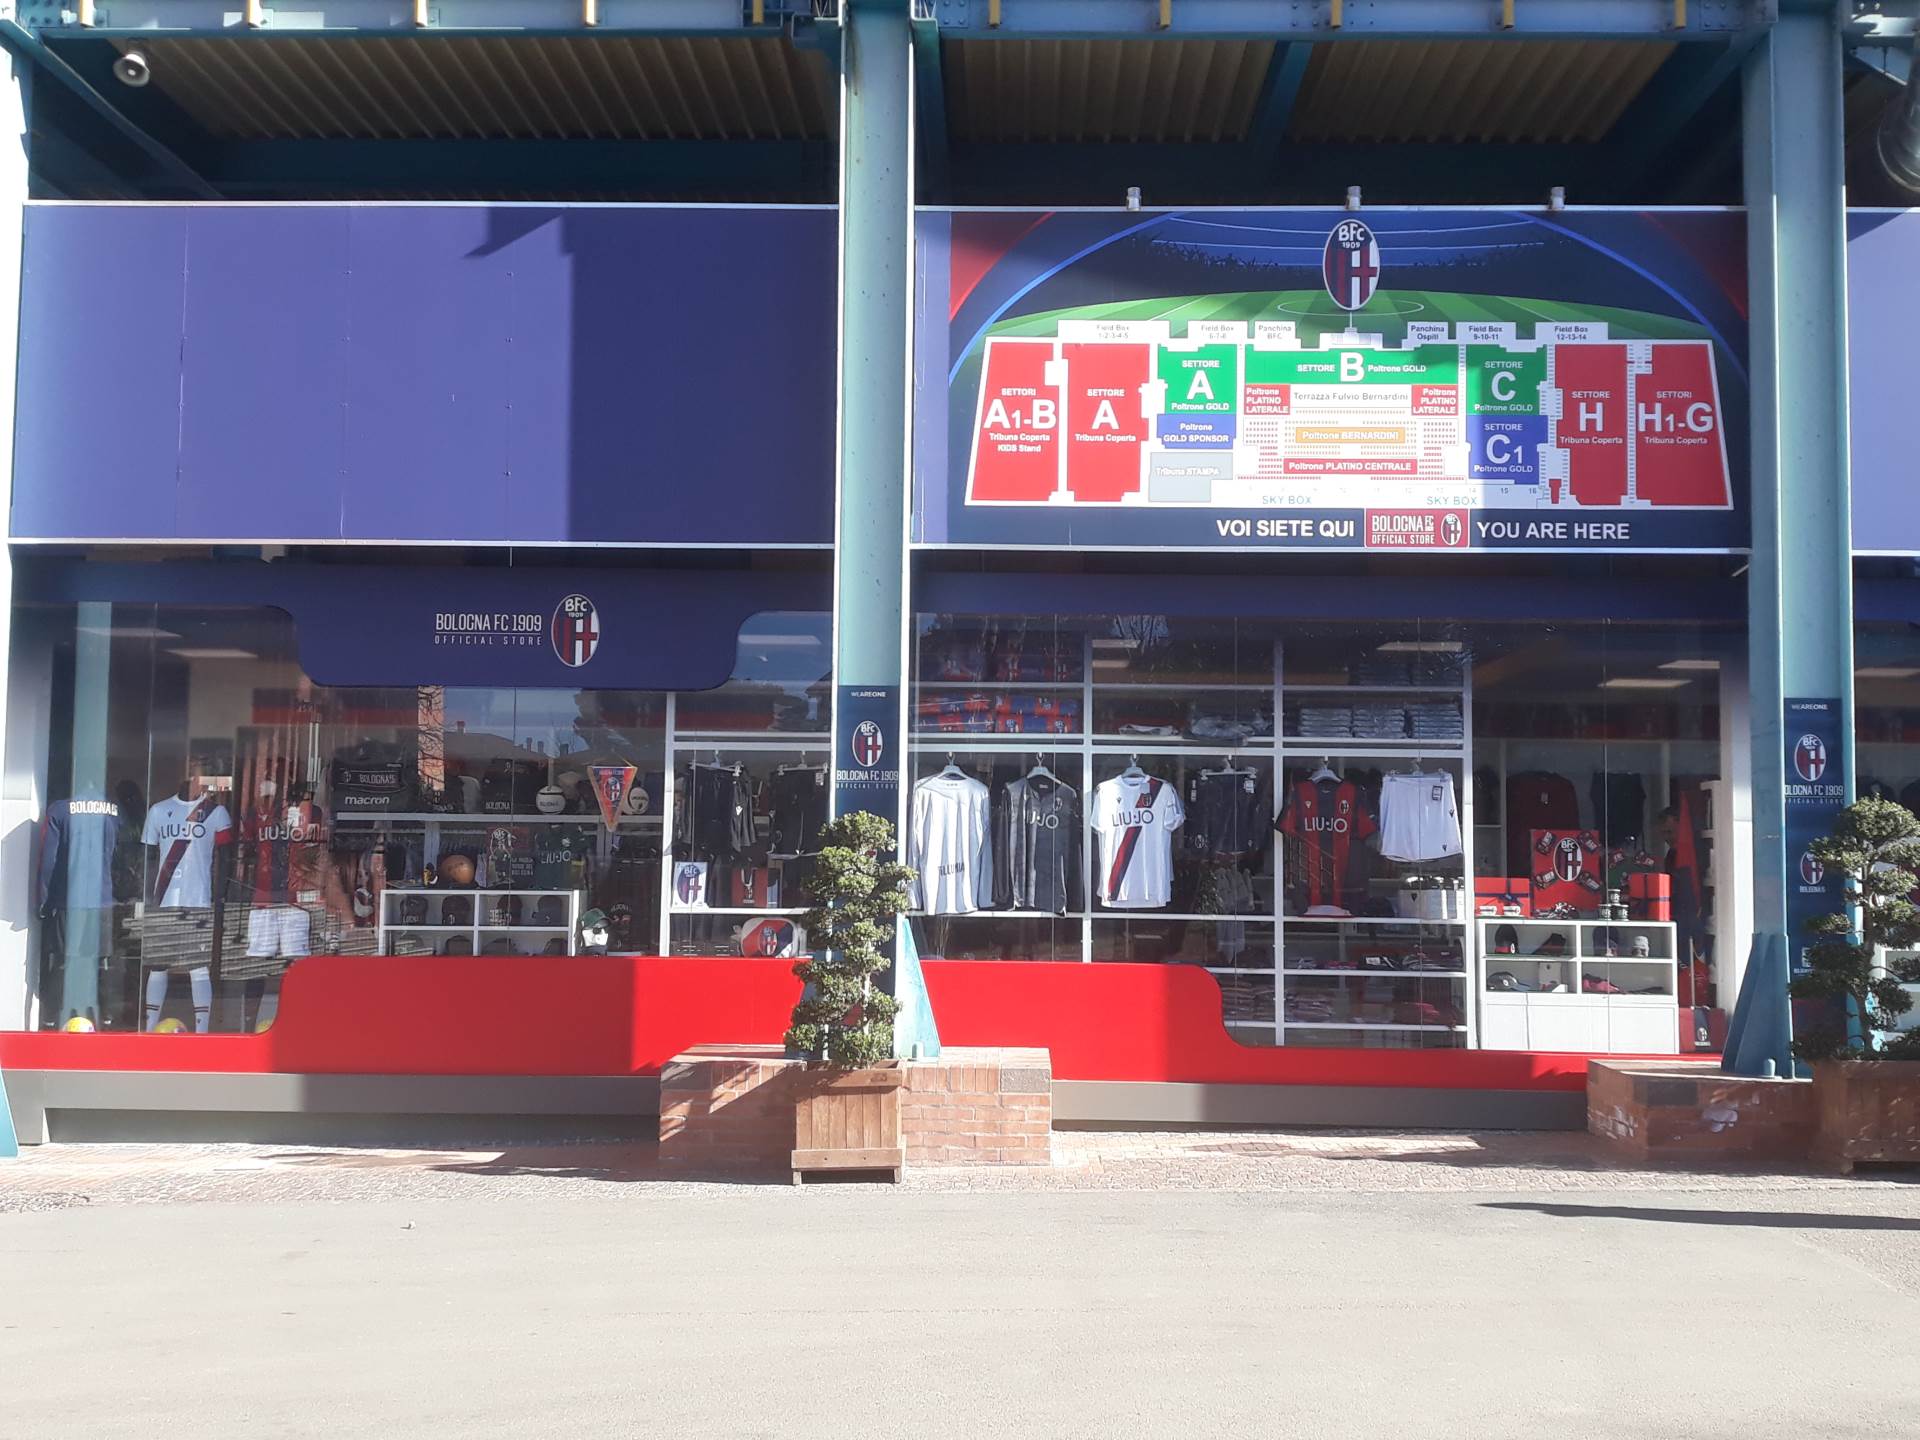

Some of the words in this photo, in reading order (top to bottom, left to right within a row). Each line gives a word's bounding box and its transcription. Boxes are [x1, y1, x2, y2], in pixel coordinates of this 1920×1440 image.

[1338, 223, 1365, 241] BFC
[1342, 241, 1360, 249] 1909
[1182, 360, 1220, 368] SETTORE
[1296, 364, 1335, 372] SETTORE
[1340, 352, 1365, 382] B
[1367, 364, 1400, 373] Poltrone
[1402, 364, 1426, 373] GOLD
[1484, 361, 1523, 369] SETTORE
[1186, 369, 1214, 400] A
[1491, 371, 1516, 401] C
[1001, 388, 1036, 396] SETTORI
[1087, 389, 1125, 397] SETTORE
[1246, 387, 1279, 395] Poltrone
[1423, 388, 1456, 396] Poltrone
[1572, 391, 1611, 399] SETTORE
[1656, 391, 1692, 399] SETTORI
[1294, 392, 1329, 400] Terrazza
[1332, 392, 1359, 400] Fulvio
[1362, 392, 1408, 400] Bernardini
[1246, 397, 1282, 405] PLATINO
[1420, 397, 1457, 405] PLATINO
[1171, 402, 1204, 411] Poltrone
[1205, 402, 1229, 411] GOLD
[1246, 406, 1289, 414] LATERALE
[1413, 406, 1456, 414] LATERALE
[983, 399, 1057, 429] A1-B
[1091, 400, 1120, 429] A
[1579, 402, 1603, 432] H
[1638, 402, 1714, 433] H1-G
[1180, 423, 1212, 431] Poltrone
[1485, 423, 1523, 431] SETTORE
[989, 433, 1018, 441] Tribuna
[1019, 433, 1050, 442] Coperta
[1075, 433, 1104, 442] Tribuna
[1105, 434, 1136, 443] Coperta
[1163, 434, 1187, 442] GOLD
[1188, 434, 1229, 442] SPONSOR
[1302, 431, 1339, 439] Poltrone
[1341, 431, 1399, 439] BERNARDINI
[1560, 436, 1589, 444] Tribuna
[1592, 437, 1623, 445] Coperta
[1677, 437, 1707, 445] Coperta
[1018, 444, 1041, 452] Stand
[1486, 434, 1523, 464] C1
[1289, 462, 1323, 470] Poltrone
[1325, 462, 1363, 470] PLATINO
[1364, 462, 1412, 471] CENTRALE
[1474, 465, 1507, 473] Poltrone
[1509, 465, 1533, 473] GOLD
[1262, 496, 1284, 505] SKY
[1288, 496, 1312, 505] BOX
[1427, 496, 1449, 505] SKY
[1453, 496, 1477, 505] BOX
[1372, 515, 1424, 532] BOLOGNA
[1216, 520, 1251, 536] VOI
[1256, 520, 1314, 537] SIETE
[1319, 520, 1354, 538] QUI
[1476, 521, 1520, 539] YOU
[1525, 522, 1567, 539] ARE
[1574, 523, 1630, 540] HERE
[1372, 535, 1407, 544] OFFICIAL
[1410, 535, 1435, 544] STORE
[565, 597, 588, 613] BFC
[436, 613, 490, 631] BOLOGNA
[494, 614, 509, 631] FC
[511, 614, 542, 632] 1909
[434, 635, 493, 645] OFFICIAL
[503, 636, 542, 646] STORE
[861, 723, 875, 733] BFC
[1802, 736, 1818, 746] BFC
[359, 773, 390, 785] BOLOGNA
[836, 770, 869, 781] BOLOGNA
[870, 770, 880, 781] FC
[881, 770, 899, 781] 1909
[1784, 784, 1813, 796] OLOGNA
[1814, 785, 1824, 796] FC
[1825, 785, 1844, 796] 1909
[345, 796, 390, 805] macron
[69, 800, 112, 814] BOLOGNA
